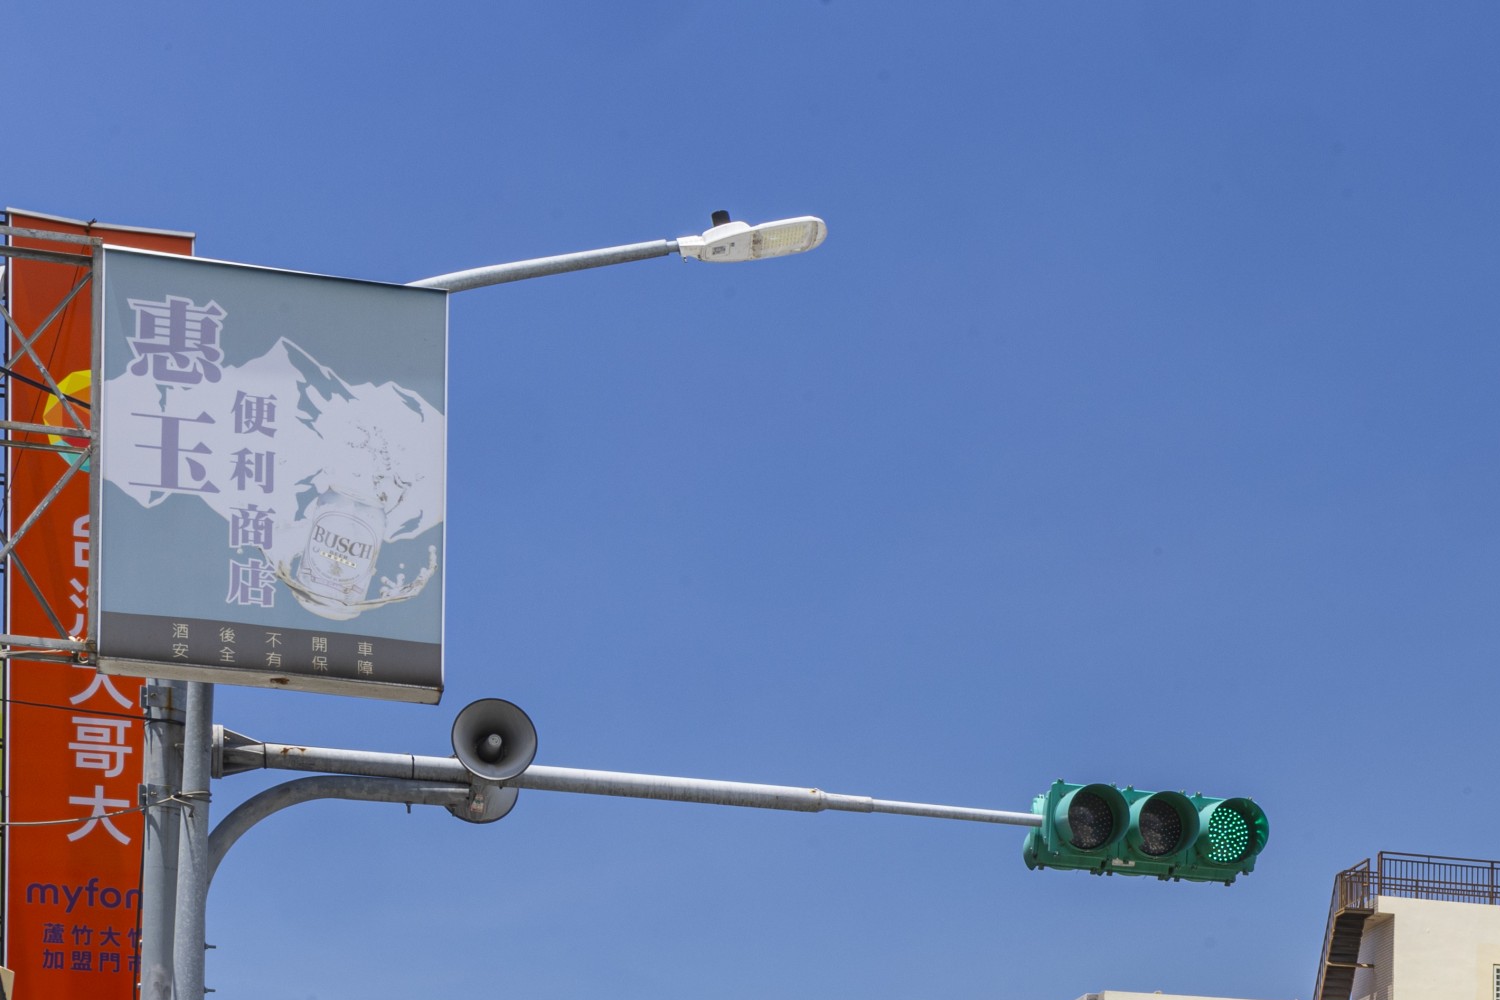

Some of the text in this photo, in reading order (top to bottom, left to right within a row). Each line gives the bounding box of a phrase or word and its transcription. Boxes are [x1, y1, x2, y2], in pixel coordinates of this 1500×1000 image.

[127, 296, 226, 494] 惠玉
[227, 390, 279, 608] 便利商店
[313, 525, 373, 559] BUSCH
[172, 622, 374, 657] 酒後不開車
[172, 643, 374, 676] 安全有保障
[66, 512, 135, 847] 大哥大
[26, 877, 143, 914] myfon
